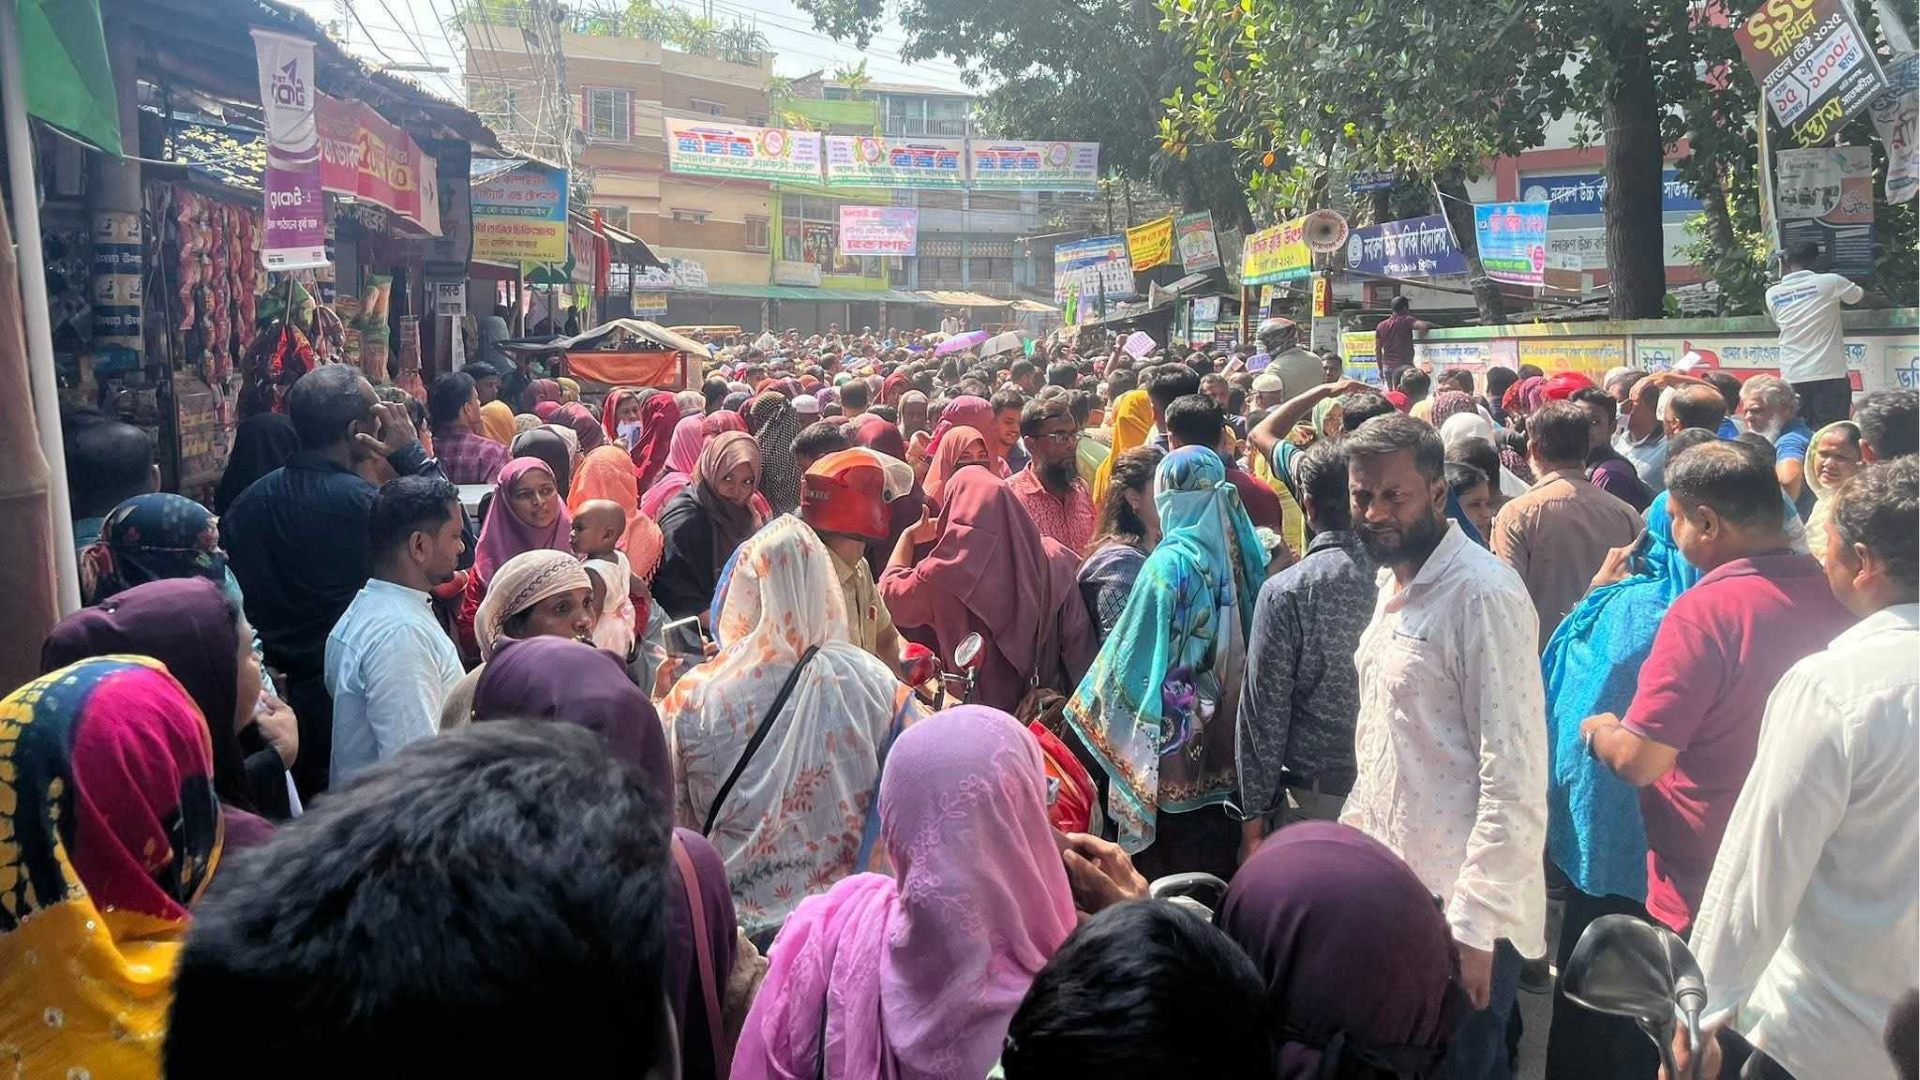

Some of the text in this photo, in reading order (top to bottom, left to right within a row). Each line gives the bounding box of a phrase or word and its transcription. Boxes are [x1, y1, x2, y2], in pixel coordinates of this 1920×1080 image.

[1769, 9, 1817, 58] দাখিল
[1763, 56, 1794, 89] মডেল
[1813, 12, 1843, 41] ২০২৫
[1775, 89, 1798, 112] ১৫
[1841, 73, 1876, 106] সাতক্ষীরা
[1550, 186, 1577, 203] নবারুণ
[1579, 181, 1594, 202] উচ্চ
[1384, 227, 1397, 256] উচ্চ
[1397, 224, 1419, 257] বালিকা
[1577, 235, 1592, 251] উচ্চ
